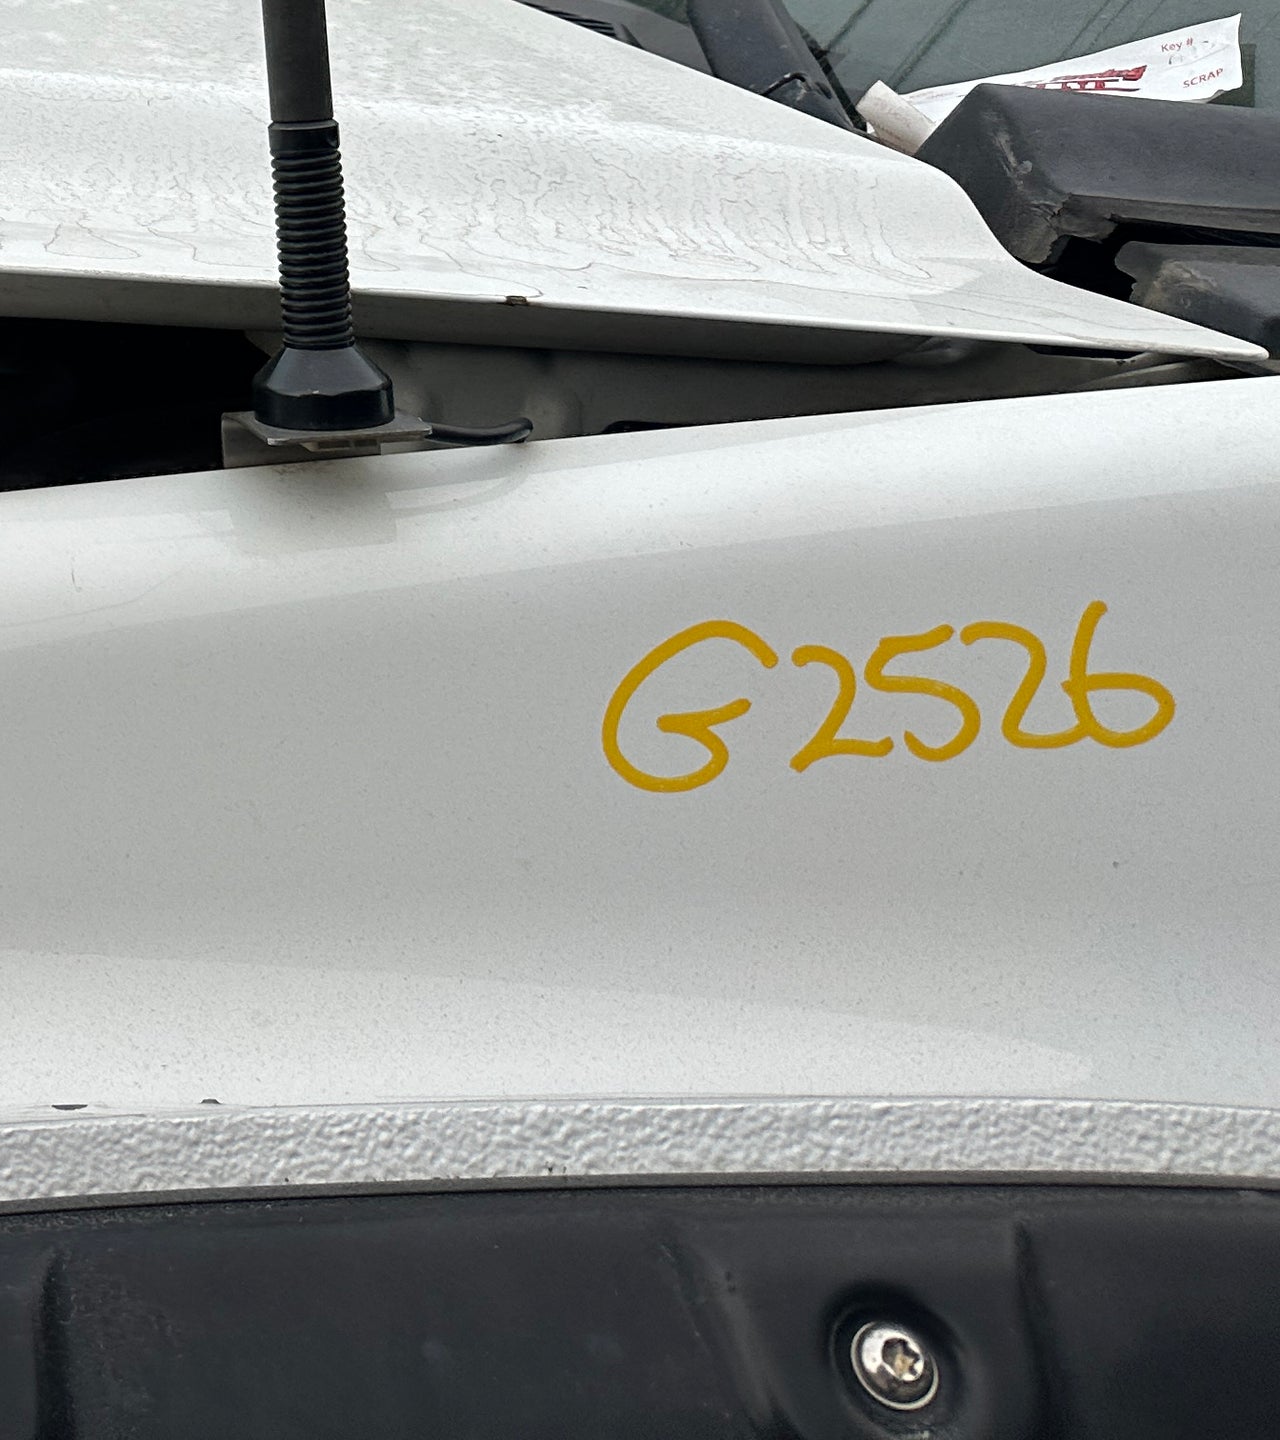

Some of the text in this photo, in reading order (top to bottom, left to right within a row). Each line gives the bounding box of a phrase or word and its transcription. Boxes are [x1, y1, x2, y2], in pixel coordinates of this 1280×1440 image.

[1161, 42, 1183, 52] Key
[1183, 68, 1224, 88] SCRAP
[602, 601, 1175, 793] G2526
